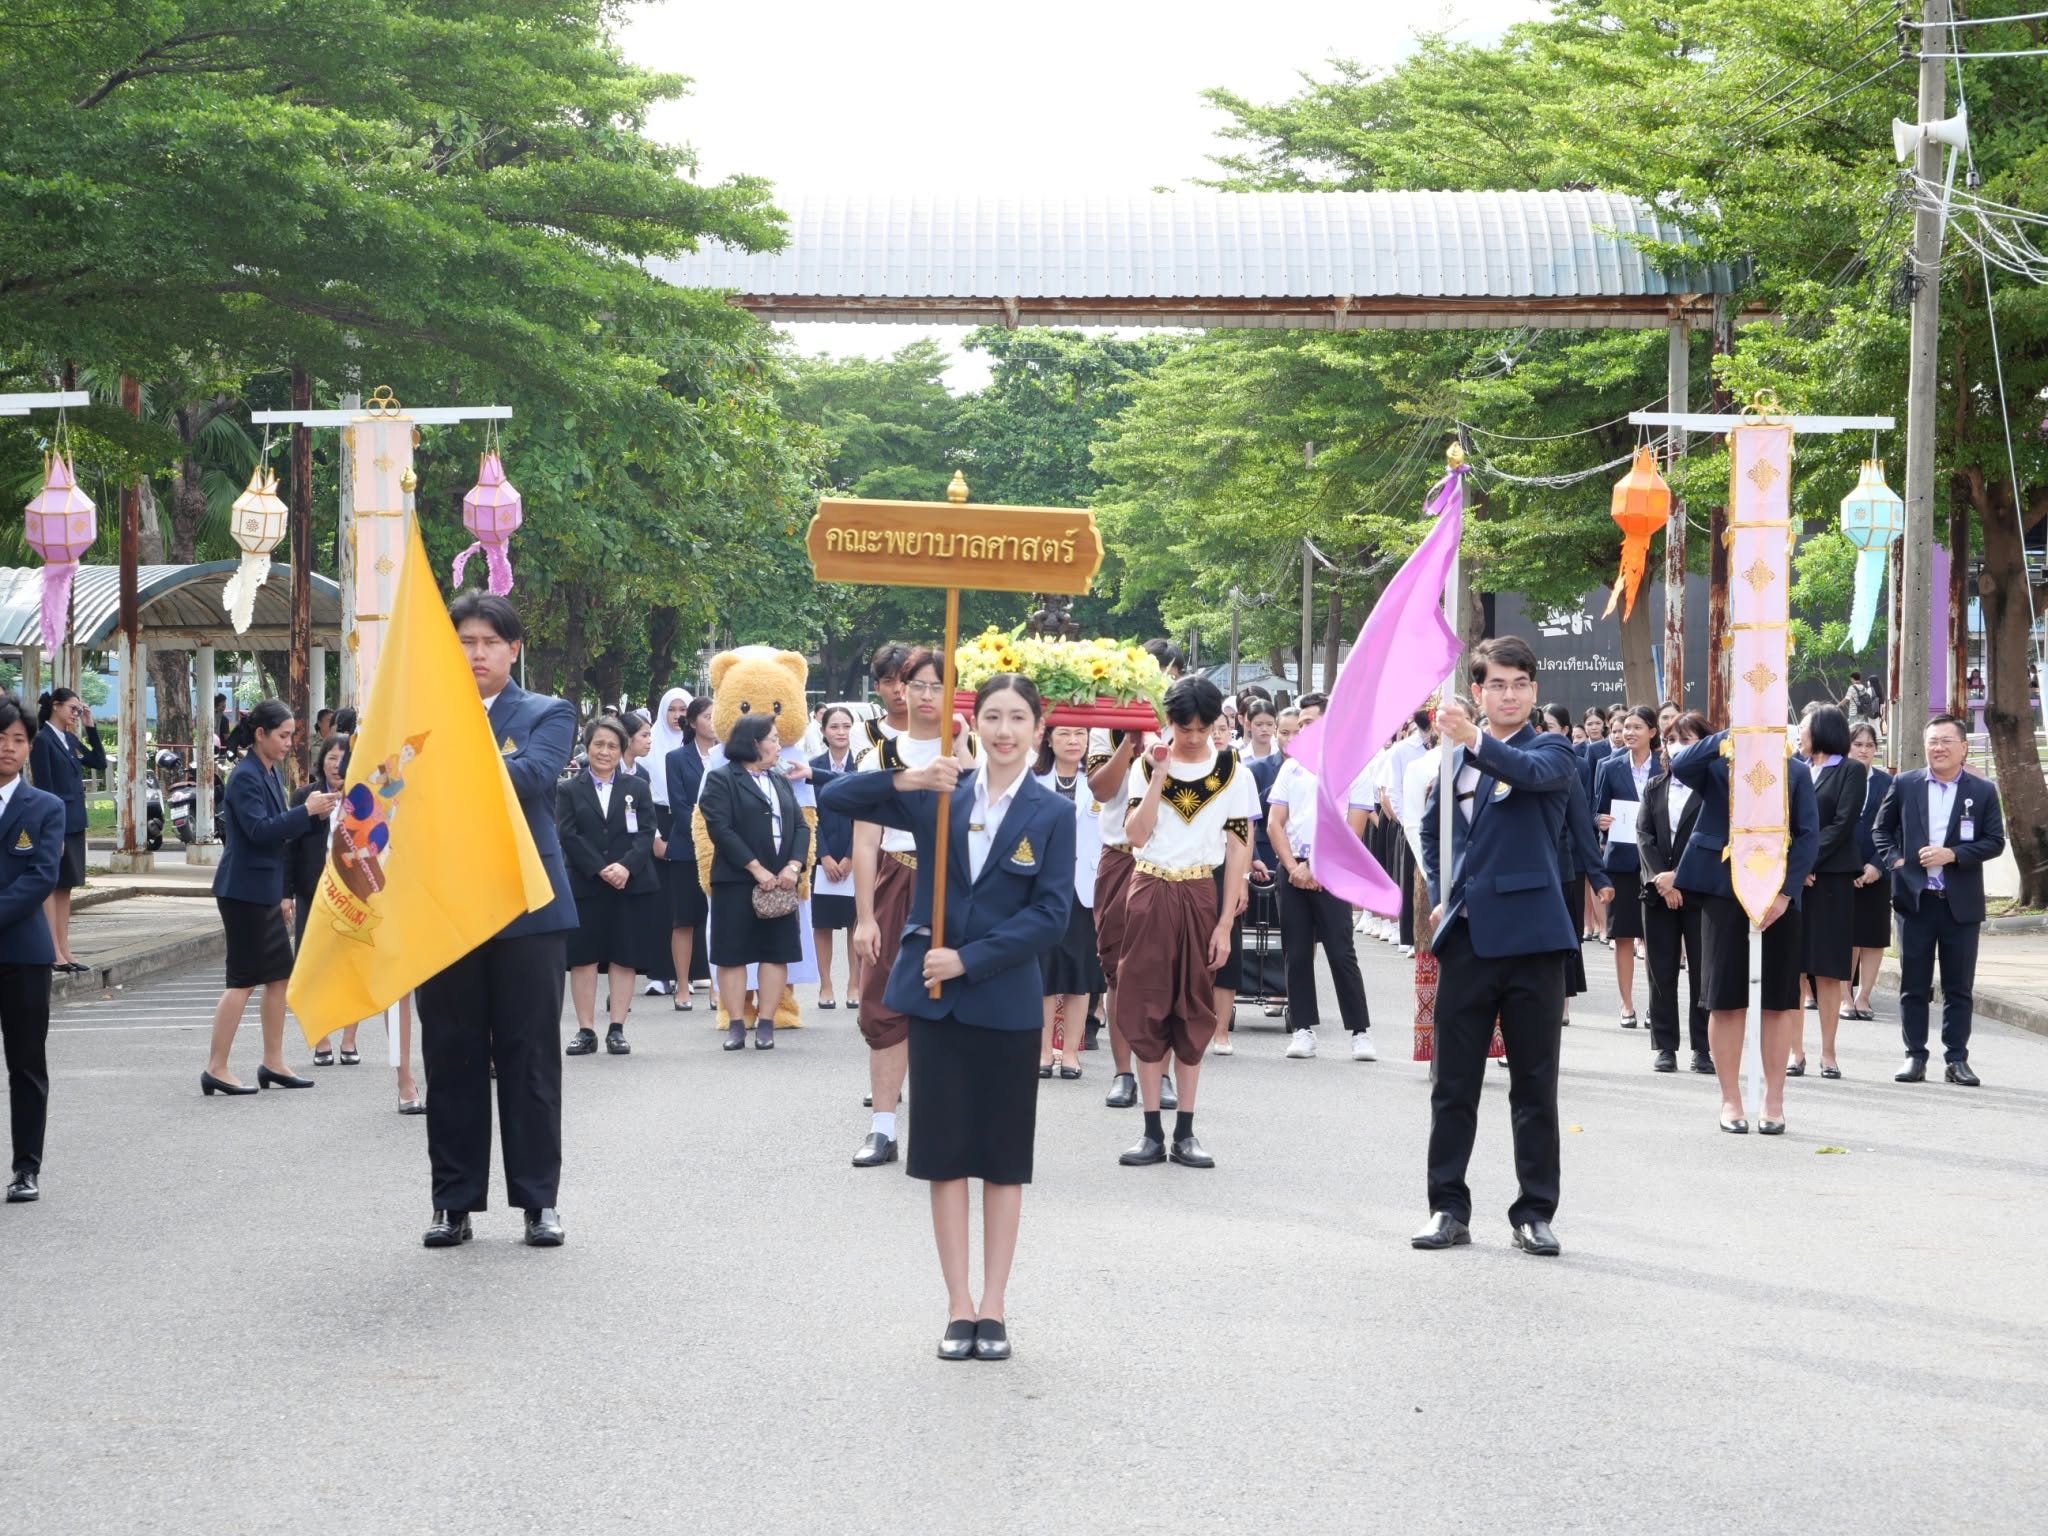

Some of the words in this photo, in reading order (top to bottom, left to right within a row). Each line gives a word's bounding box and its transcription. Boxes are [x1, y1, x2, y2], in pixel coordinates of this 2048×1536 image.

[825, 527, 1079, 563] คณะพยาบาลศาสตร์
